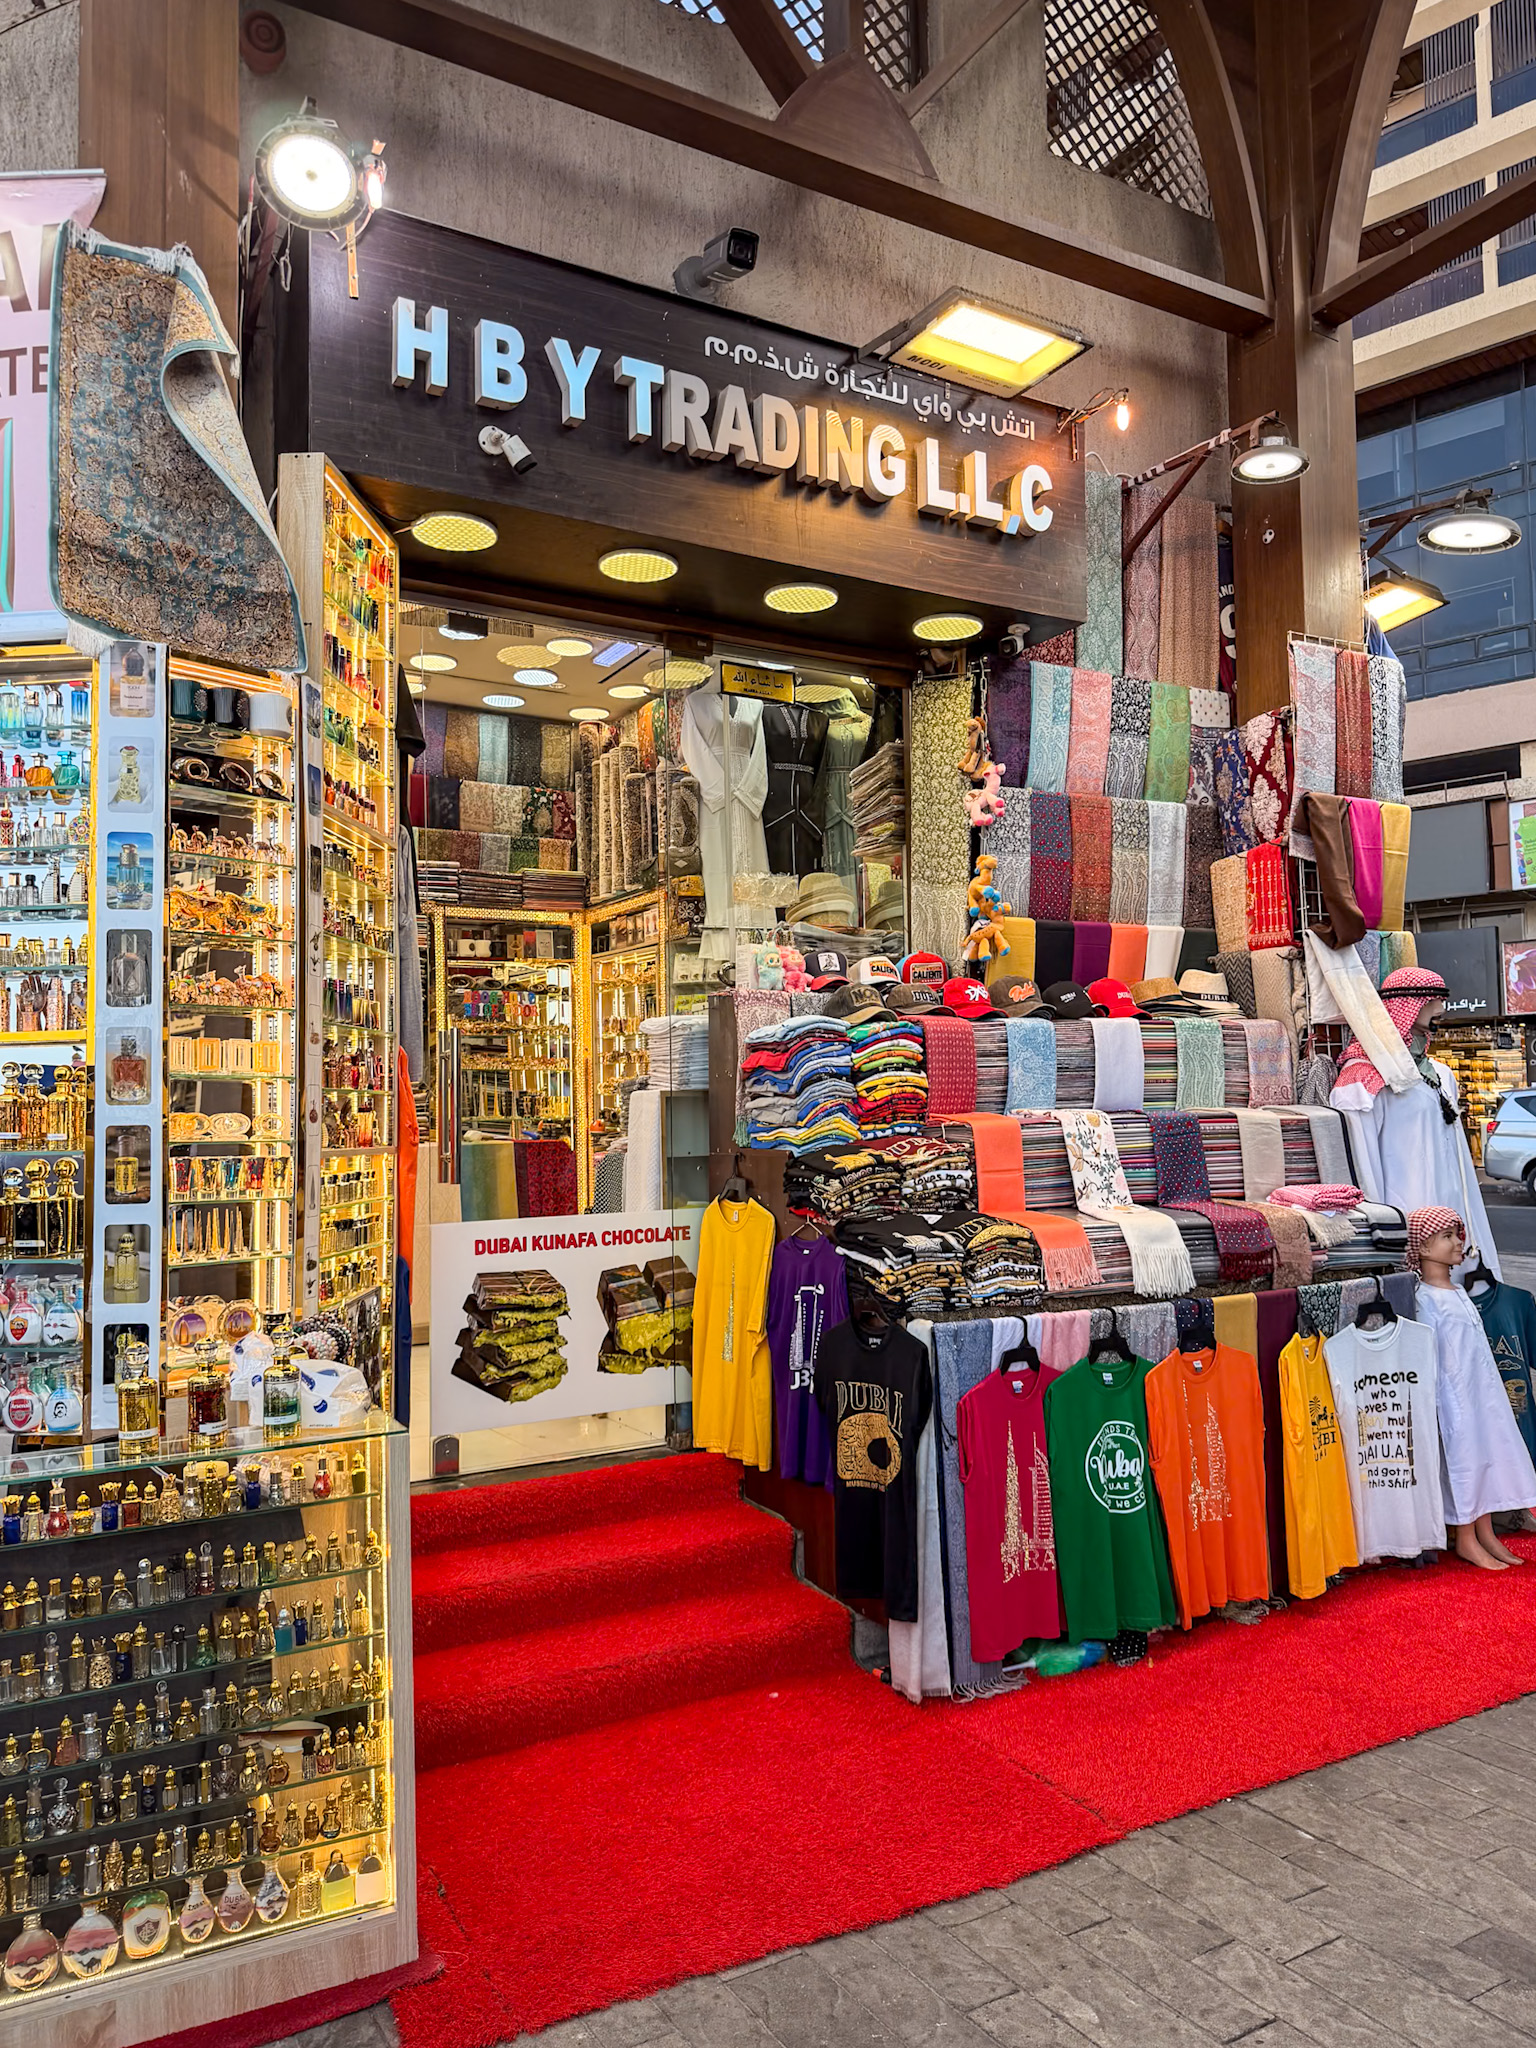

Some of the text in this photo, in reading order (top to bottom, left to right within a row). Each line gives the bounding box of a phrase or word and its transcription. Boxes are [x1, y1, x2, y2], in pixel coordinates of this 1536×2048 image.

[907, 355, 947, 370] MODI
[392, 296, 448, 395] H
[475, 319, 528, 410] B
[544, 336, 602, 427] Y
[614, 356, 906, 501] TRADING
[913, 393, 953, 423] واي
[956, 410, 988, 434] بي
[913, 970, 943, 980] CALIENTE
[474, 1226, 690, 1255] DUBAI KUNAFA CHOCOLATE
[1354, 1371, 1418, 1393] someone
[1371, 1388, 1396, 1400] who
[1367, 1430, 1393, 1441] went
[1381, 1466, 1401, 1479] got
[1368, 1479, 1386, 1489] this
